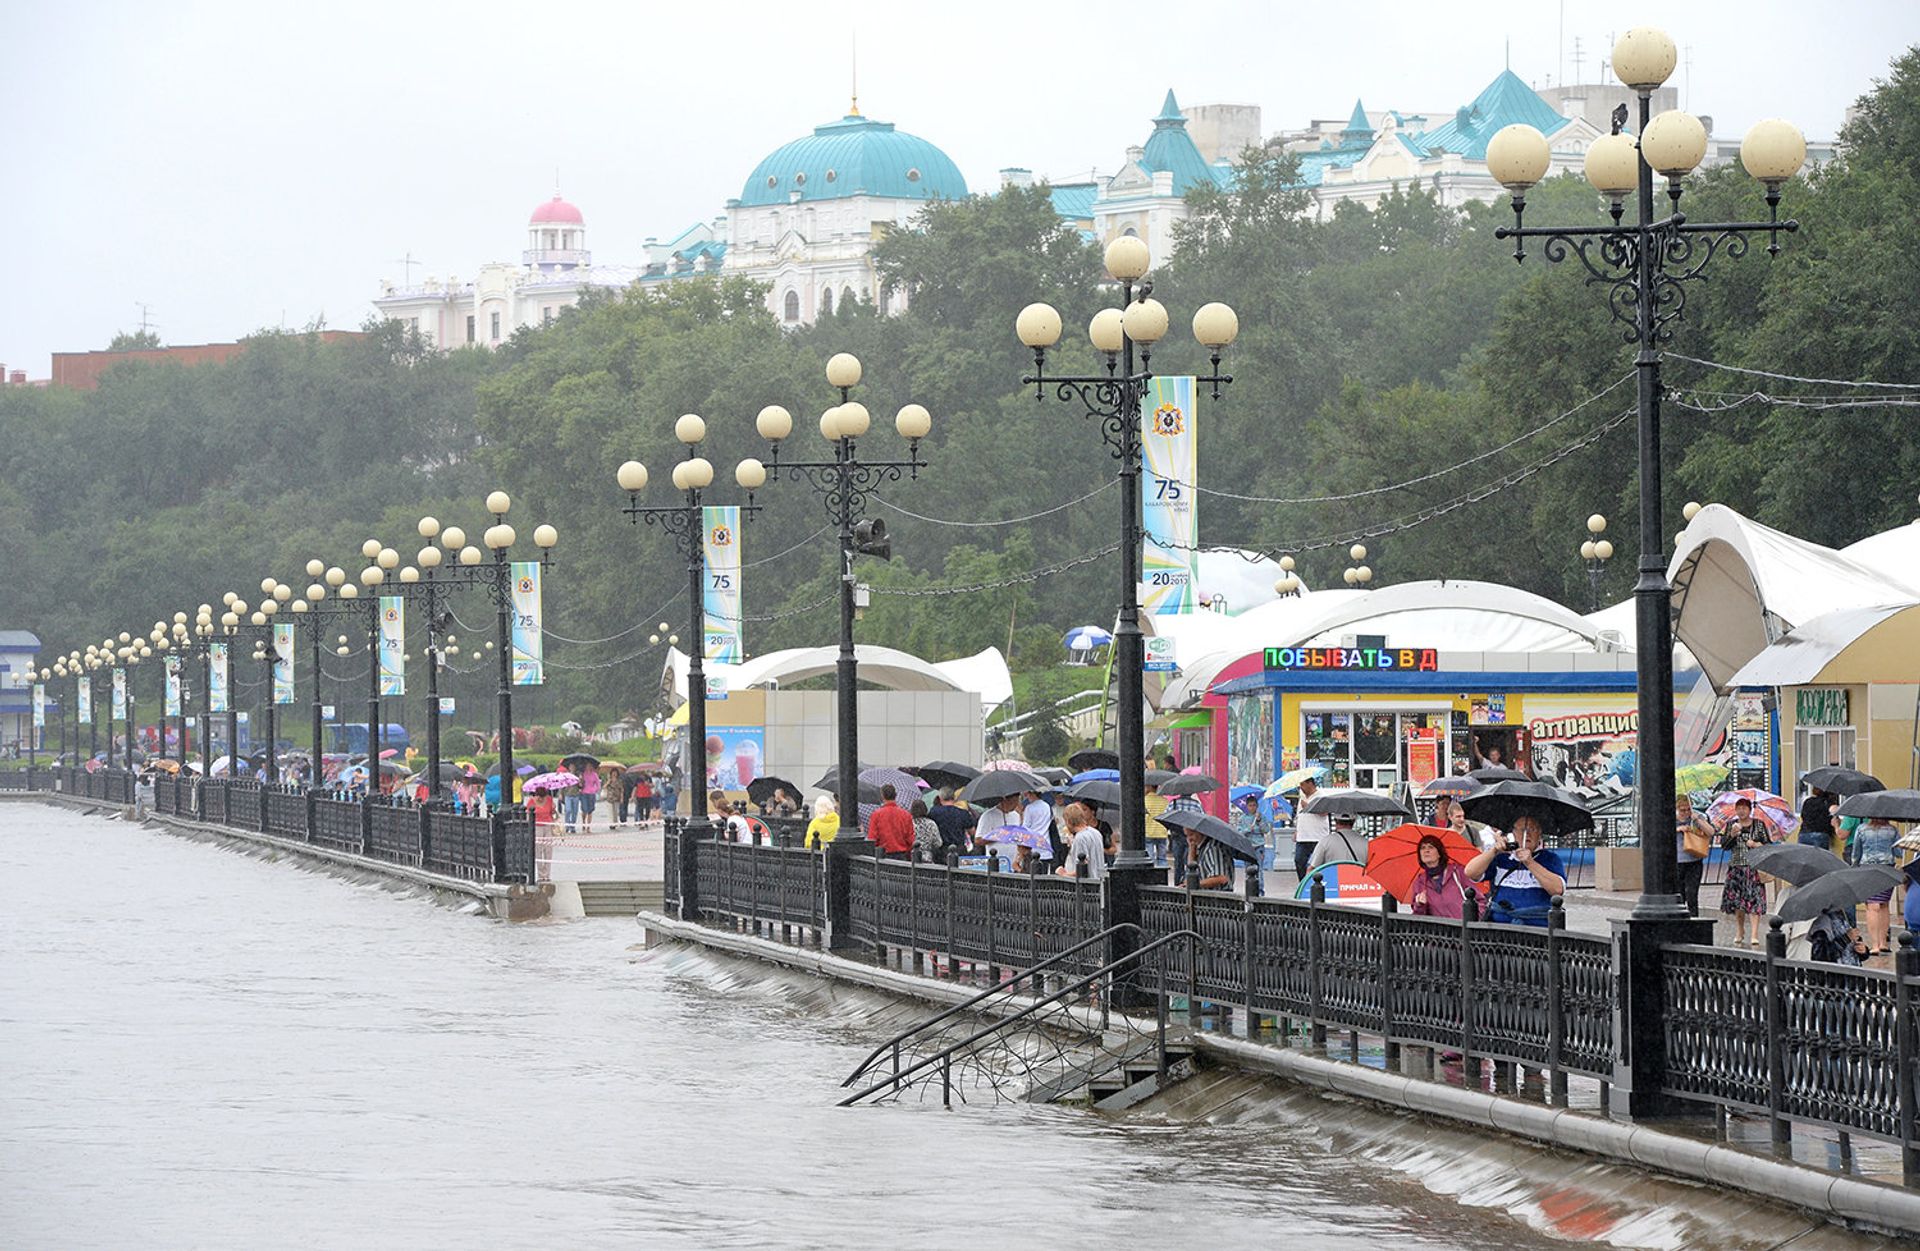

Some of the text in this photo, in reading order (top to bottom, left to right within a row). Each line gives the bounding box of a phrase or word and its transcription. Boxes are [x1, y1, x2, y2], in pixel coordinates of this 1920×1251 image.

[1154, 480, 1180, 499] 75
[712, 575, 730, 588] 75
[1152, 572, 1170, 586] 20
[519, 615, 534, 626] 75
[1264, 648, 1437, 671] ПОБЫВАТЬ В Д
[1533, 713, 1639, 738] аттракцио
